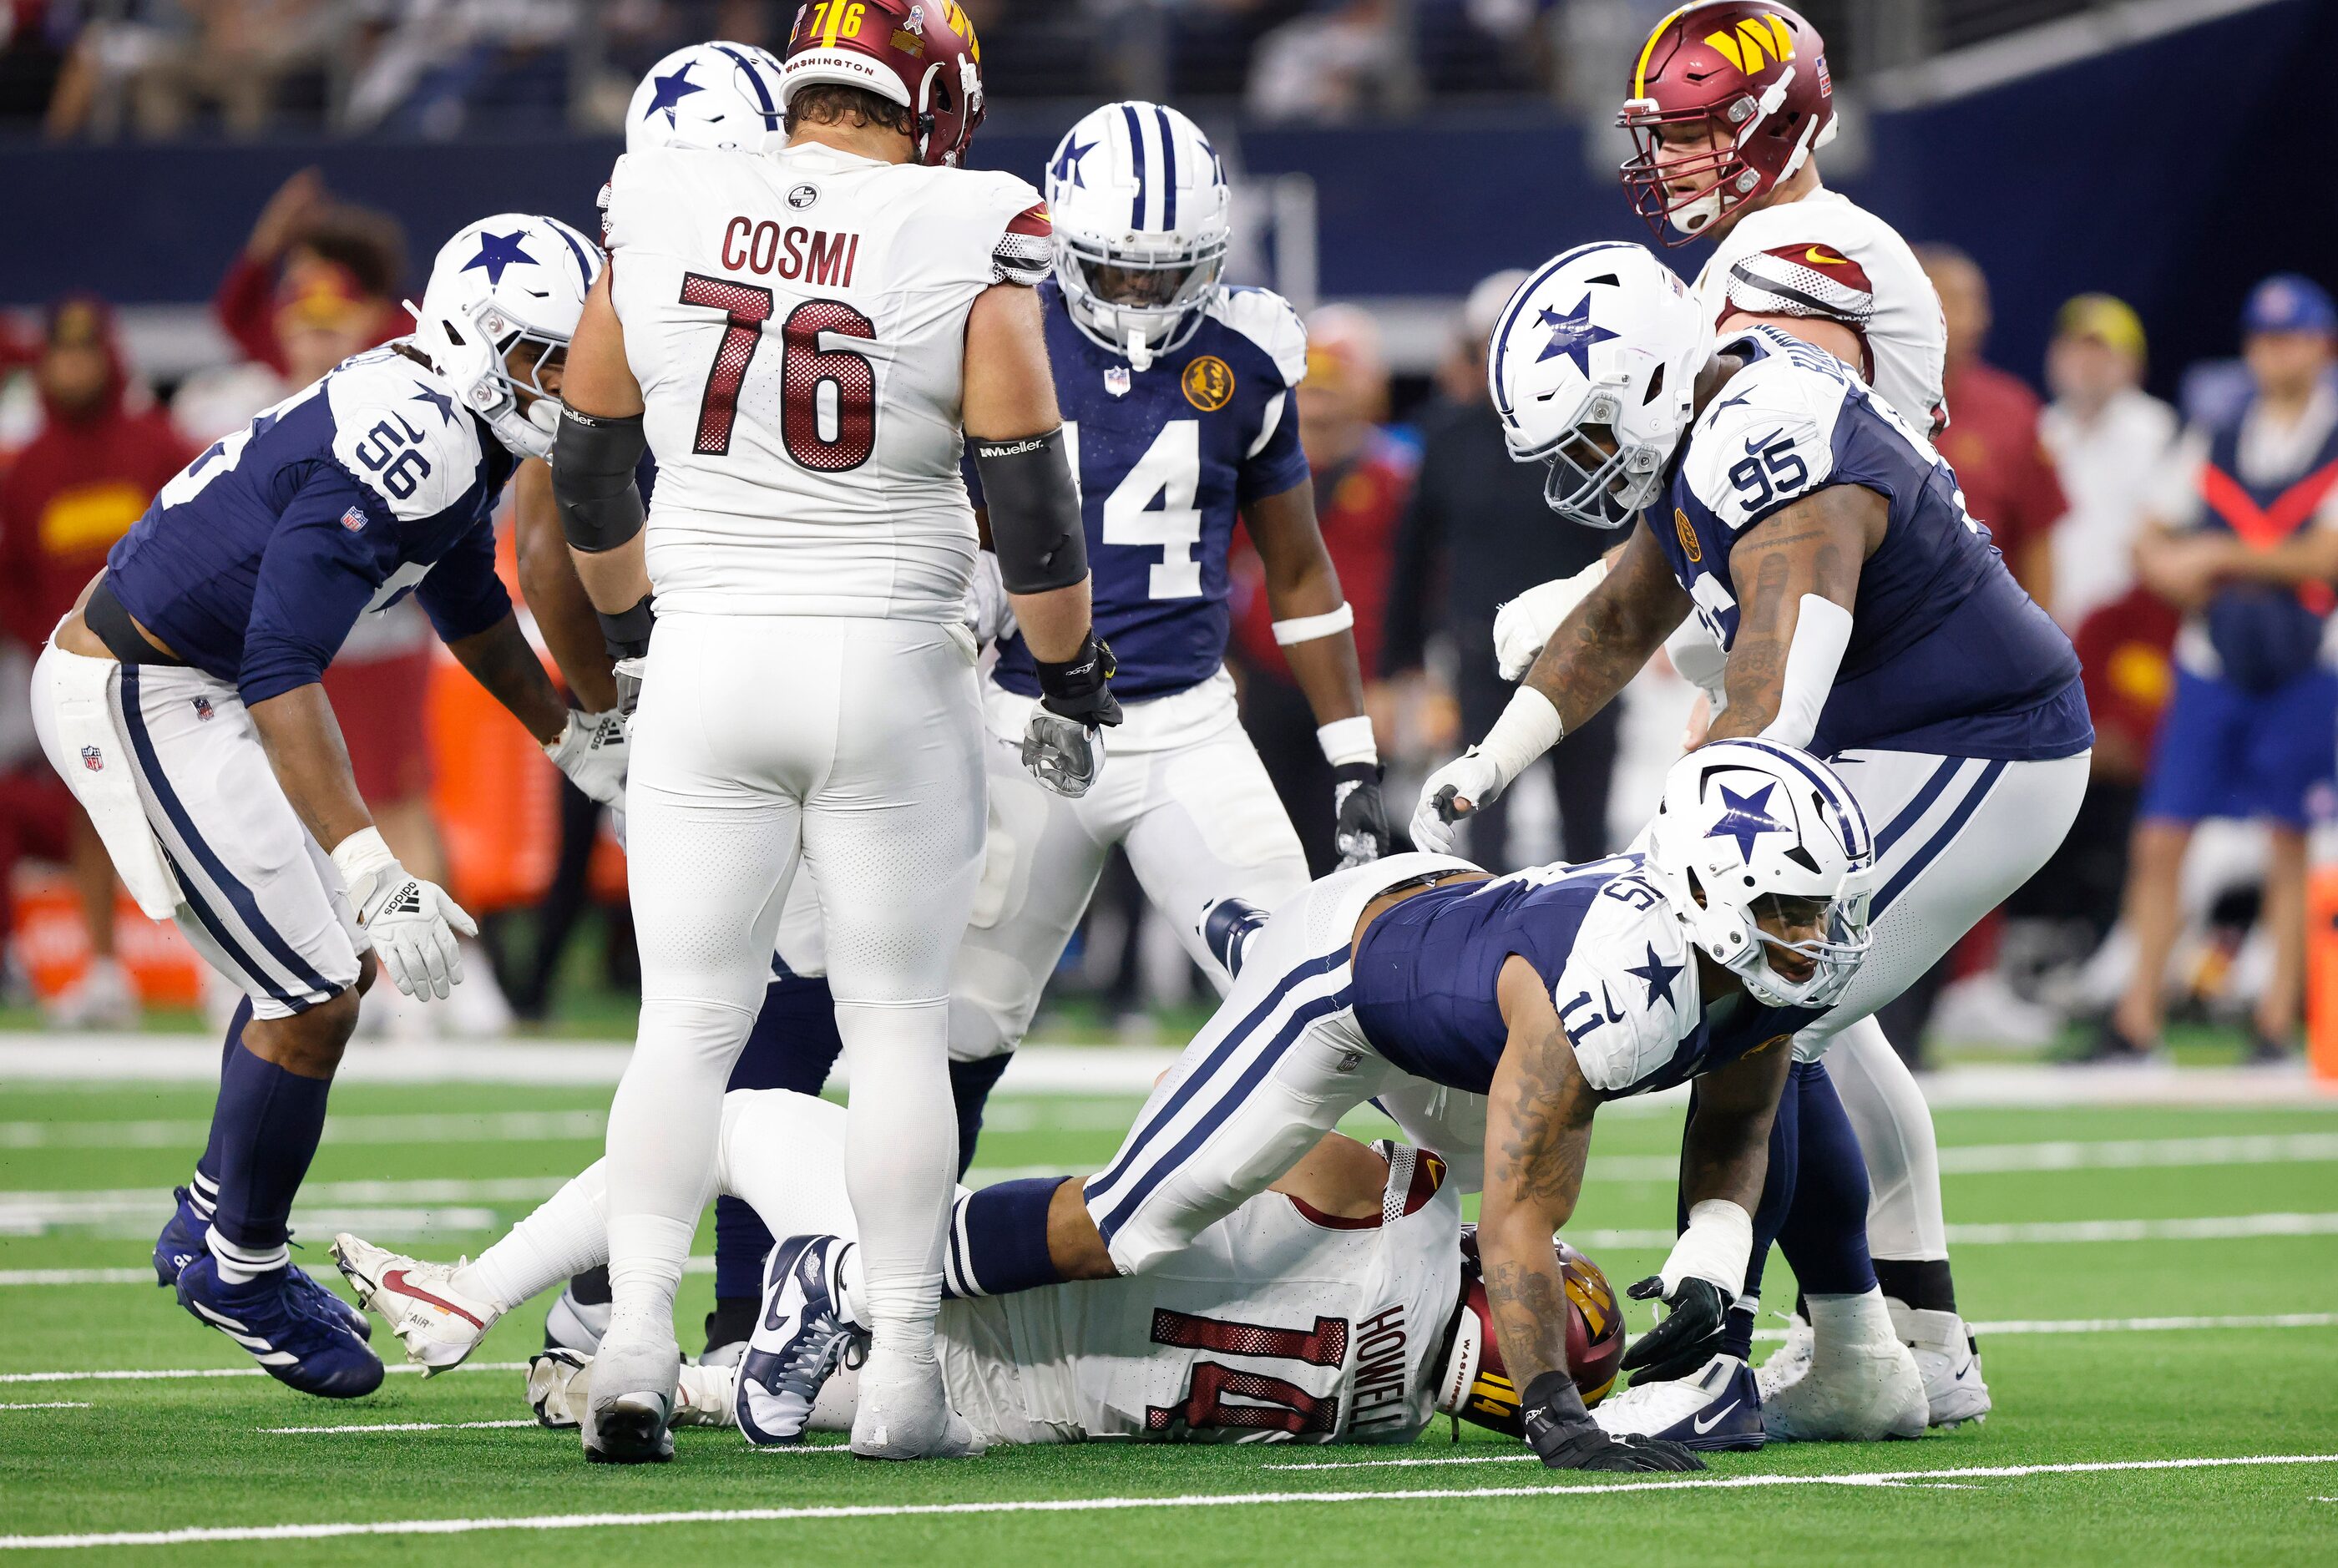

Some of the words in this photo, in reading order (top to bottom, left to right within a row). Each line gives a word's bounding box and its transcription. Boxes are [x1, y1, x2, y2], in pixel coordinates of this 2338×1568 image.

[785, 58, 874, 76] WASHINGTON
[721, 216, 859, 287] COSMI
[678, 271, 878, 473] 76
[356, 420, 431, 500] 56
[1728, 438, 1809, 512] 95
[1061, 420, 1202, 599] 4
[84, 756, 104, 770] NFL
[384, 882, 417, 915] adidas
[1559, 991, 1605, 1048] 11
[1146, 1308, 1349, 1435] 14
[1347, 1304, 1406, 1434] HOWELL
